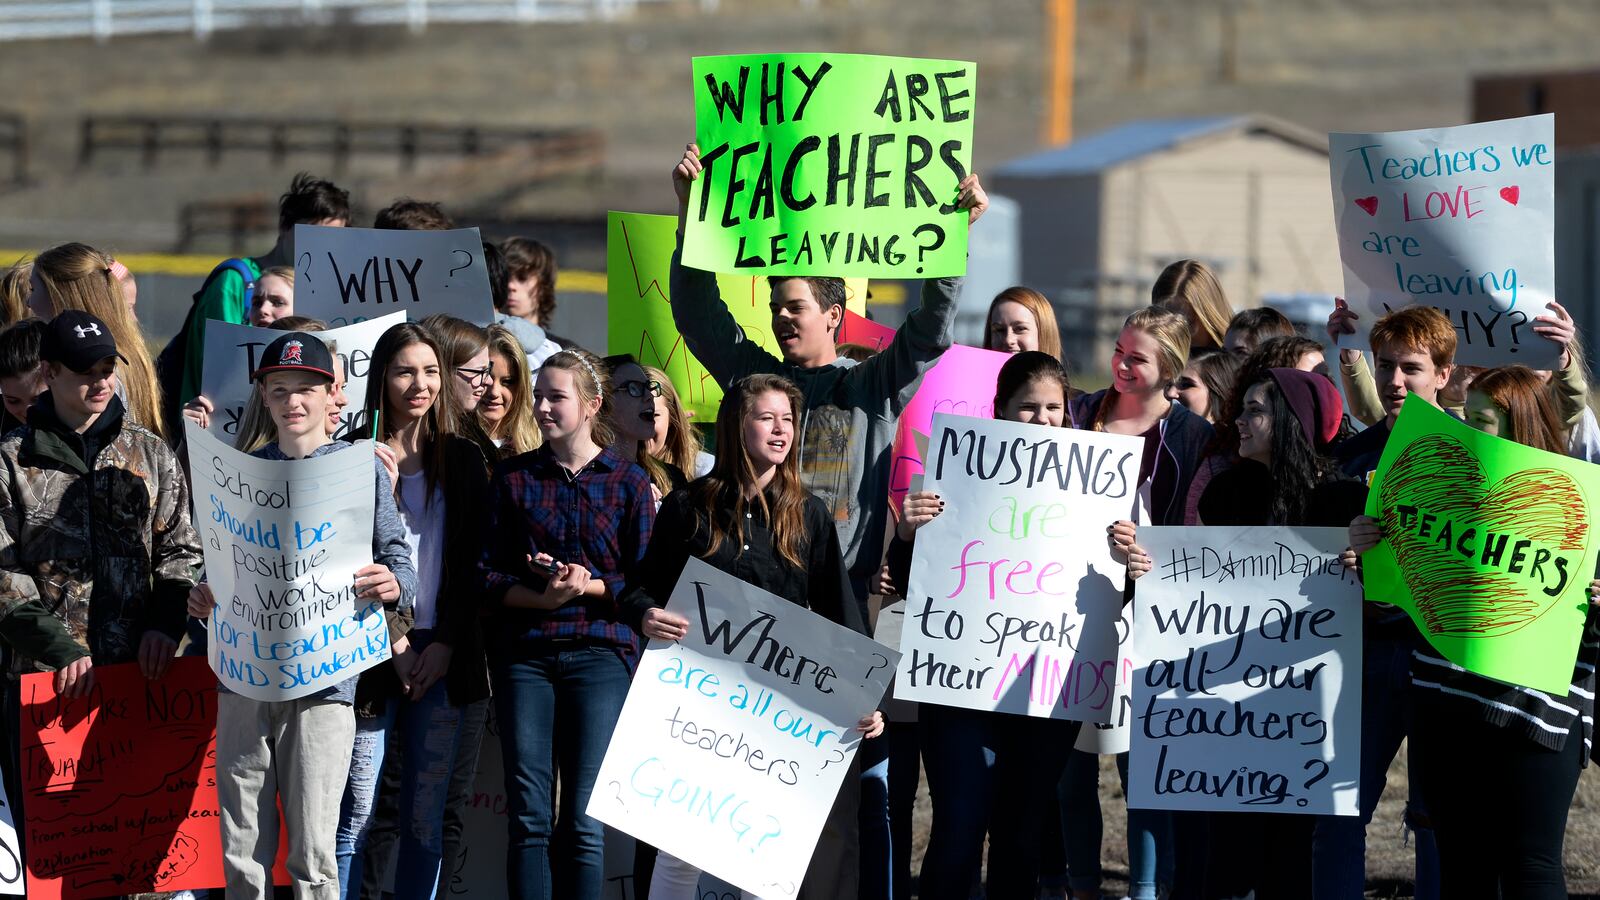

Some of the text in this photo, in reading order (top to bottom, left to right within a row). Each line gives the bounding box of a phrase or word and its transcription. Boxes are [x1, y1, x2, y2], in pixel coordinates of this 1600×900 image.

[704, 61, 970, 126] WHY ARE
[699, 132, 967, 228] TEACHERS
[1346, 143, 1552, 184] Teachers we
[1403, 185, 1489, 222] LOVE
[733, 222, 946, 274] LEAVING?
[1362, 230, 1423, 257] are
[327, 251, 424, 305] WHY
[1394, 262, 1525, 314] leaving.
[1383, 302, 1528, 353] HY?
[211, 455, 291, 509] School
[935, 426, 1134, 499] MUSTANGS
[294, 520, 338, 551] be
[987, 497, 1072, 541] are
[209, 527, 331, 583] a positive
[946, 540, 1066, 601] free
[1396, 503, 1569, 597] TEACHERS
[211, 602, 250, 646] for
[689, 580, 838, 695] Where
[913, 596, 965, 641] to
[979, 611, 1080, 658] speak
[1150, 590, 1251, 676] why
[1259, 598, 1343, 643] are
[219, 650, 270, 688] AND
[907, 648, 994, 690] their
[1144, 647, 1218, 696] all
[1242, 661, 1328, 691] our
[144, 679, 219, 724] NOT
[657, 656, 842, 749] are all our
[1137, 694, 1328, 746] teachers
[664, 705, 800, 786] teachers
[1154, 744, 1330, 807] leaving?
